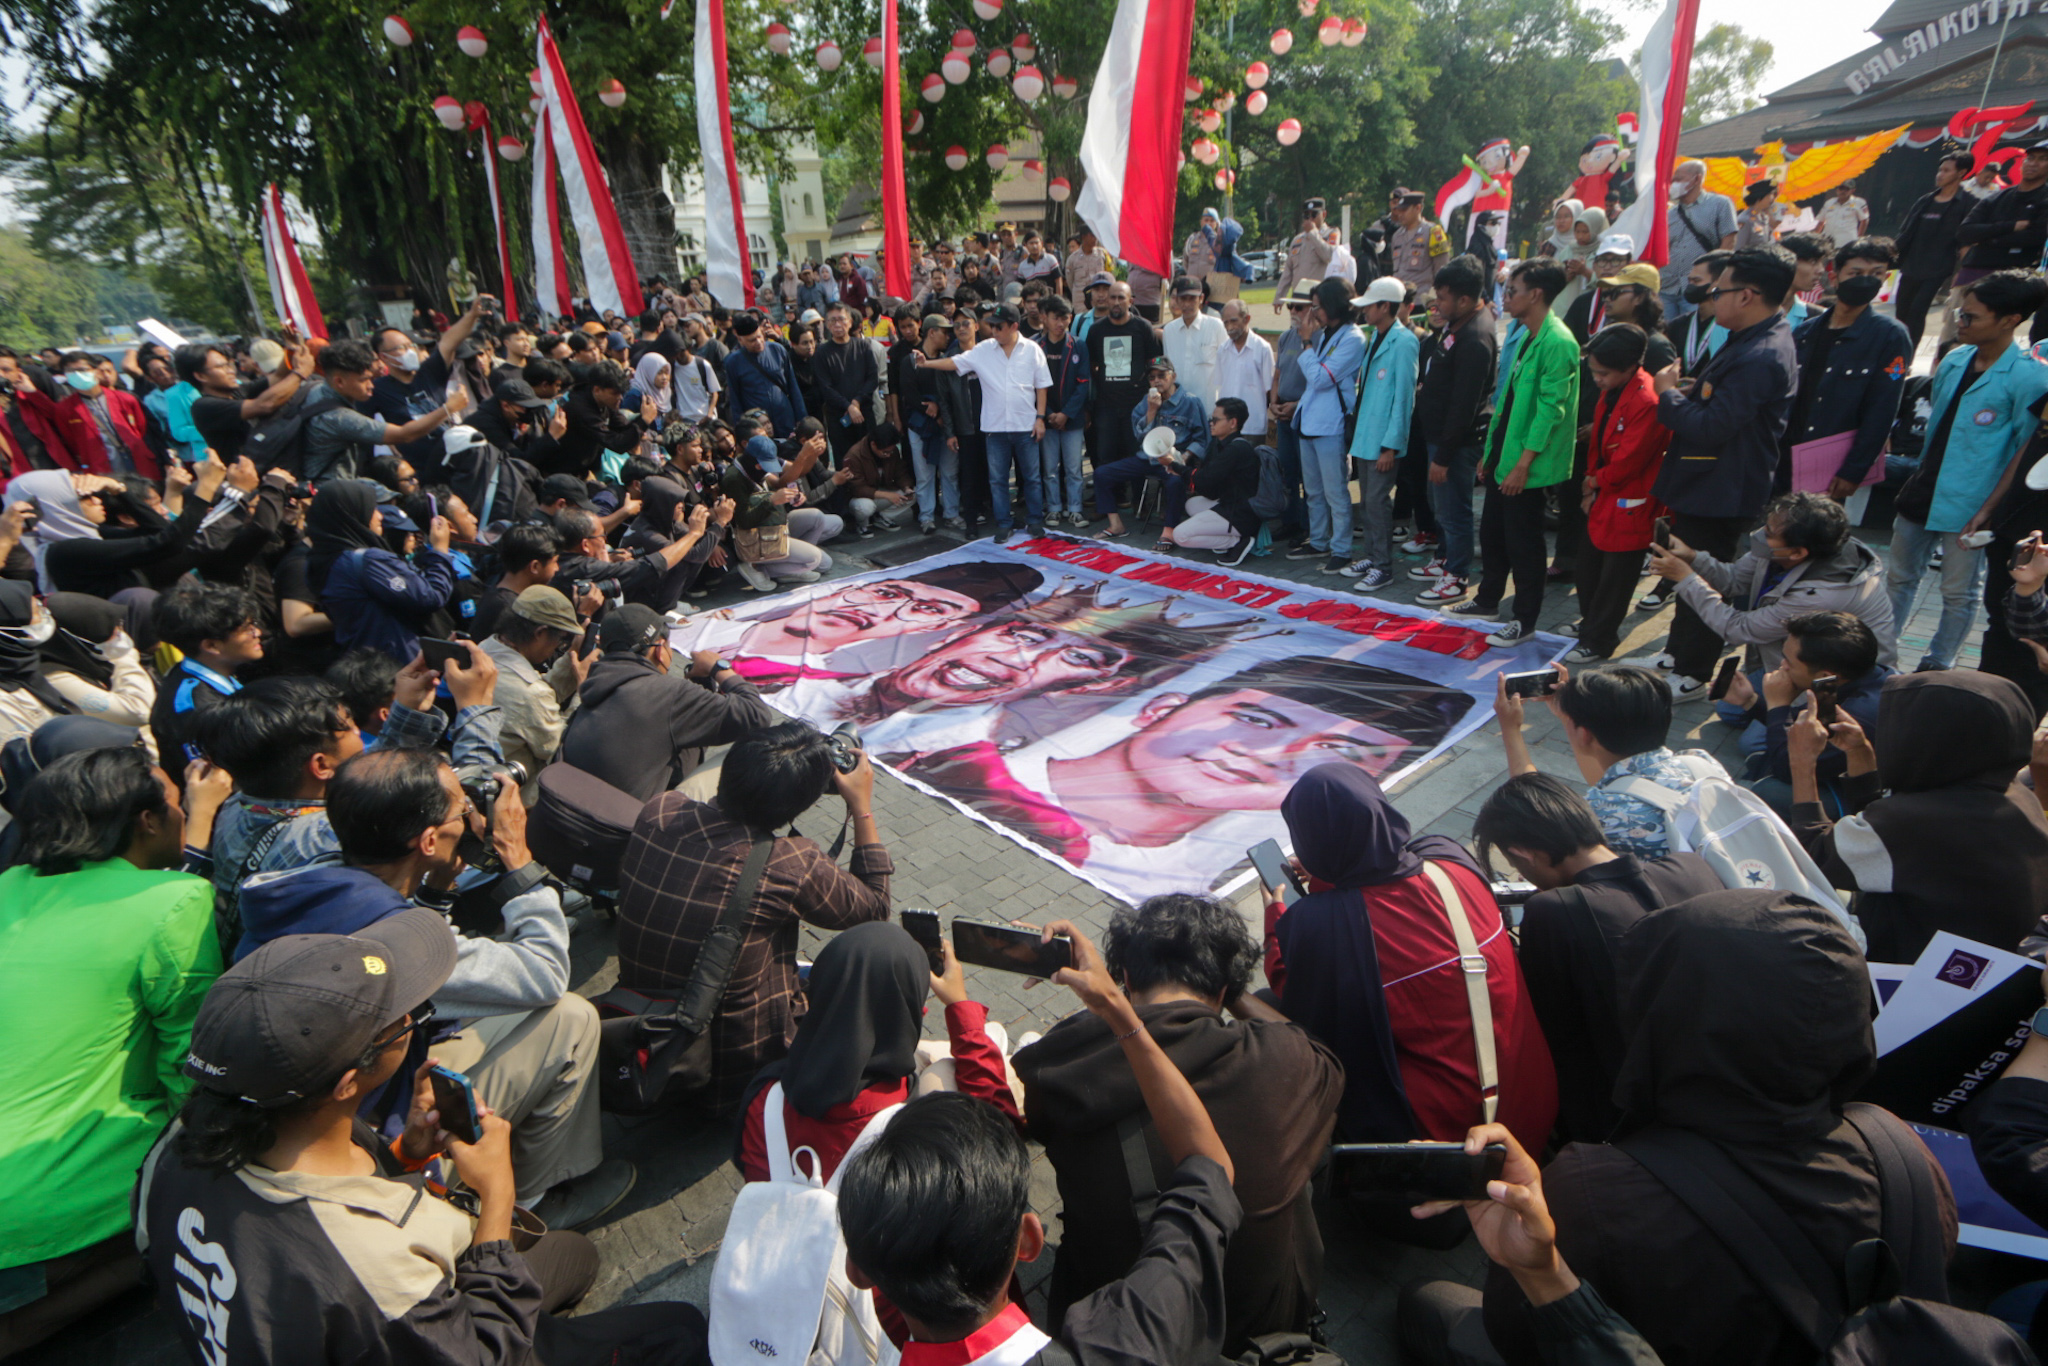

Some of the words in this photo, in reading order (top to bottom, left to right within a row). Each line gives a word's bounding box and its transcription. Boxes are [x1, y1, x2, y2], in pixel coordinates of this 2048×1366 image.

[1119, 562, 1294, 609] DINASTI
[1277, 598, 1494, 661] JOKOWI
[1931, 1051, 2010, 1114] dipaksa
